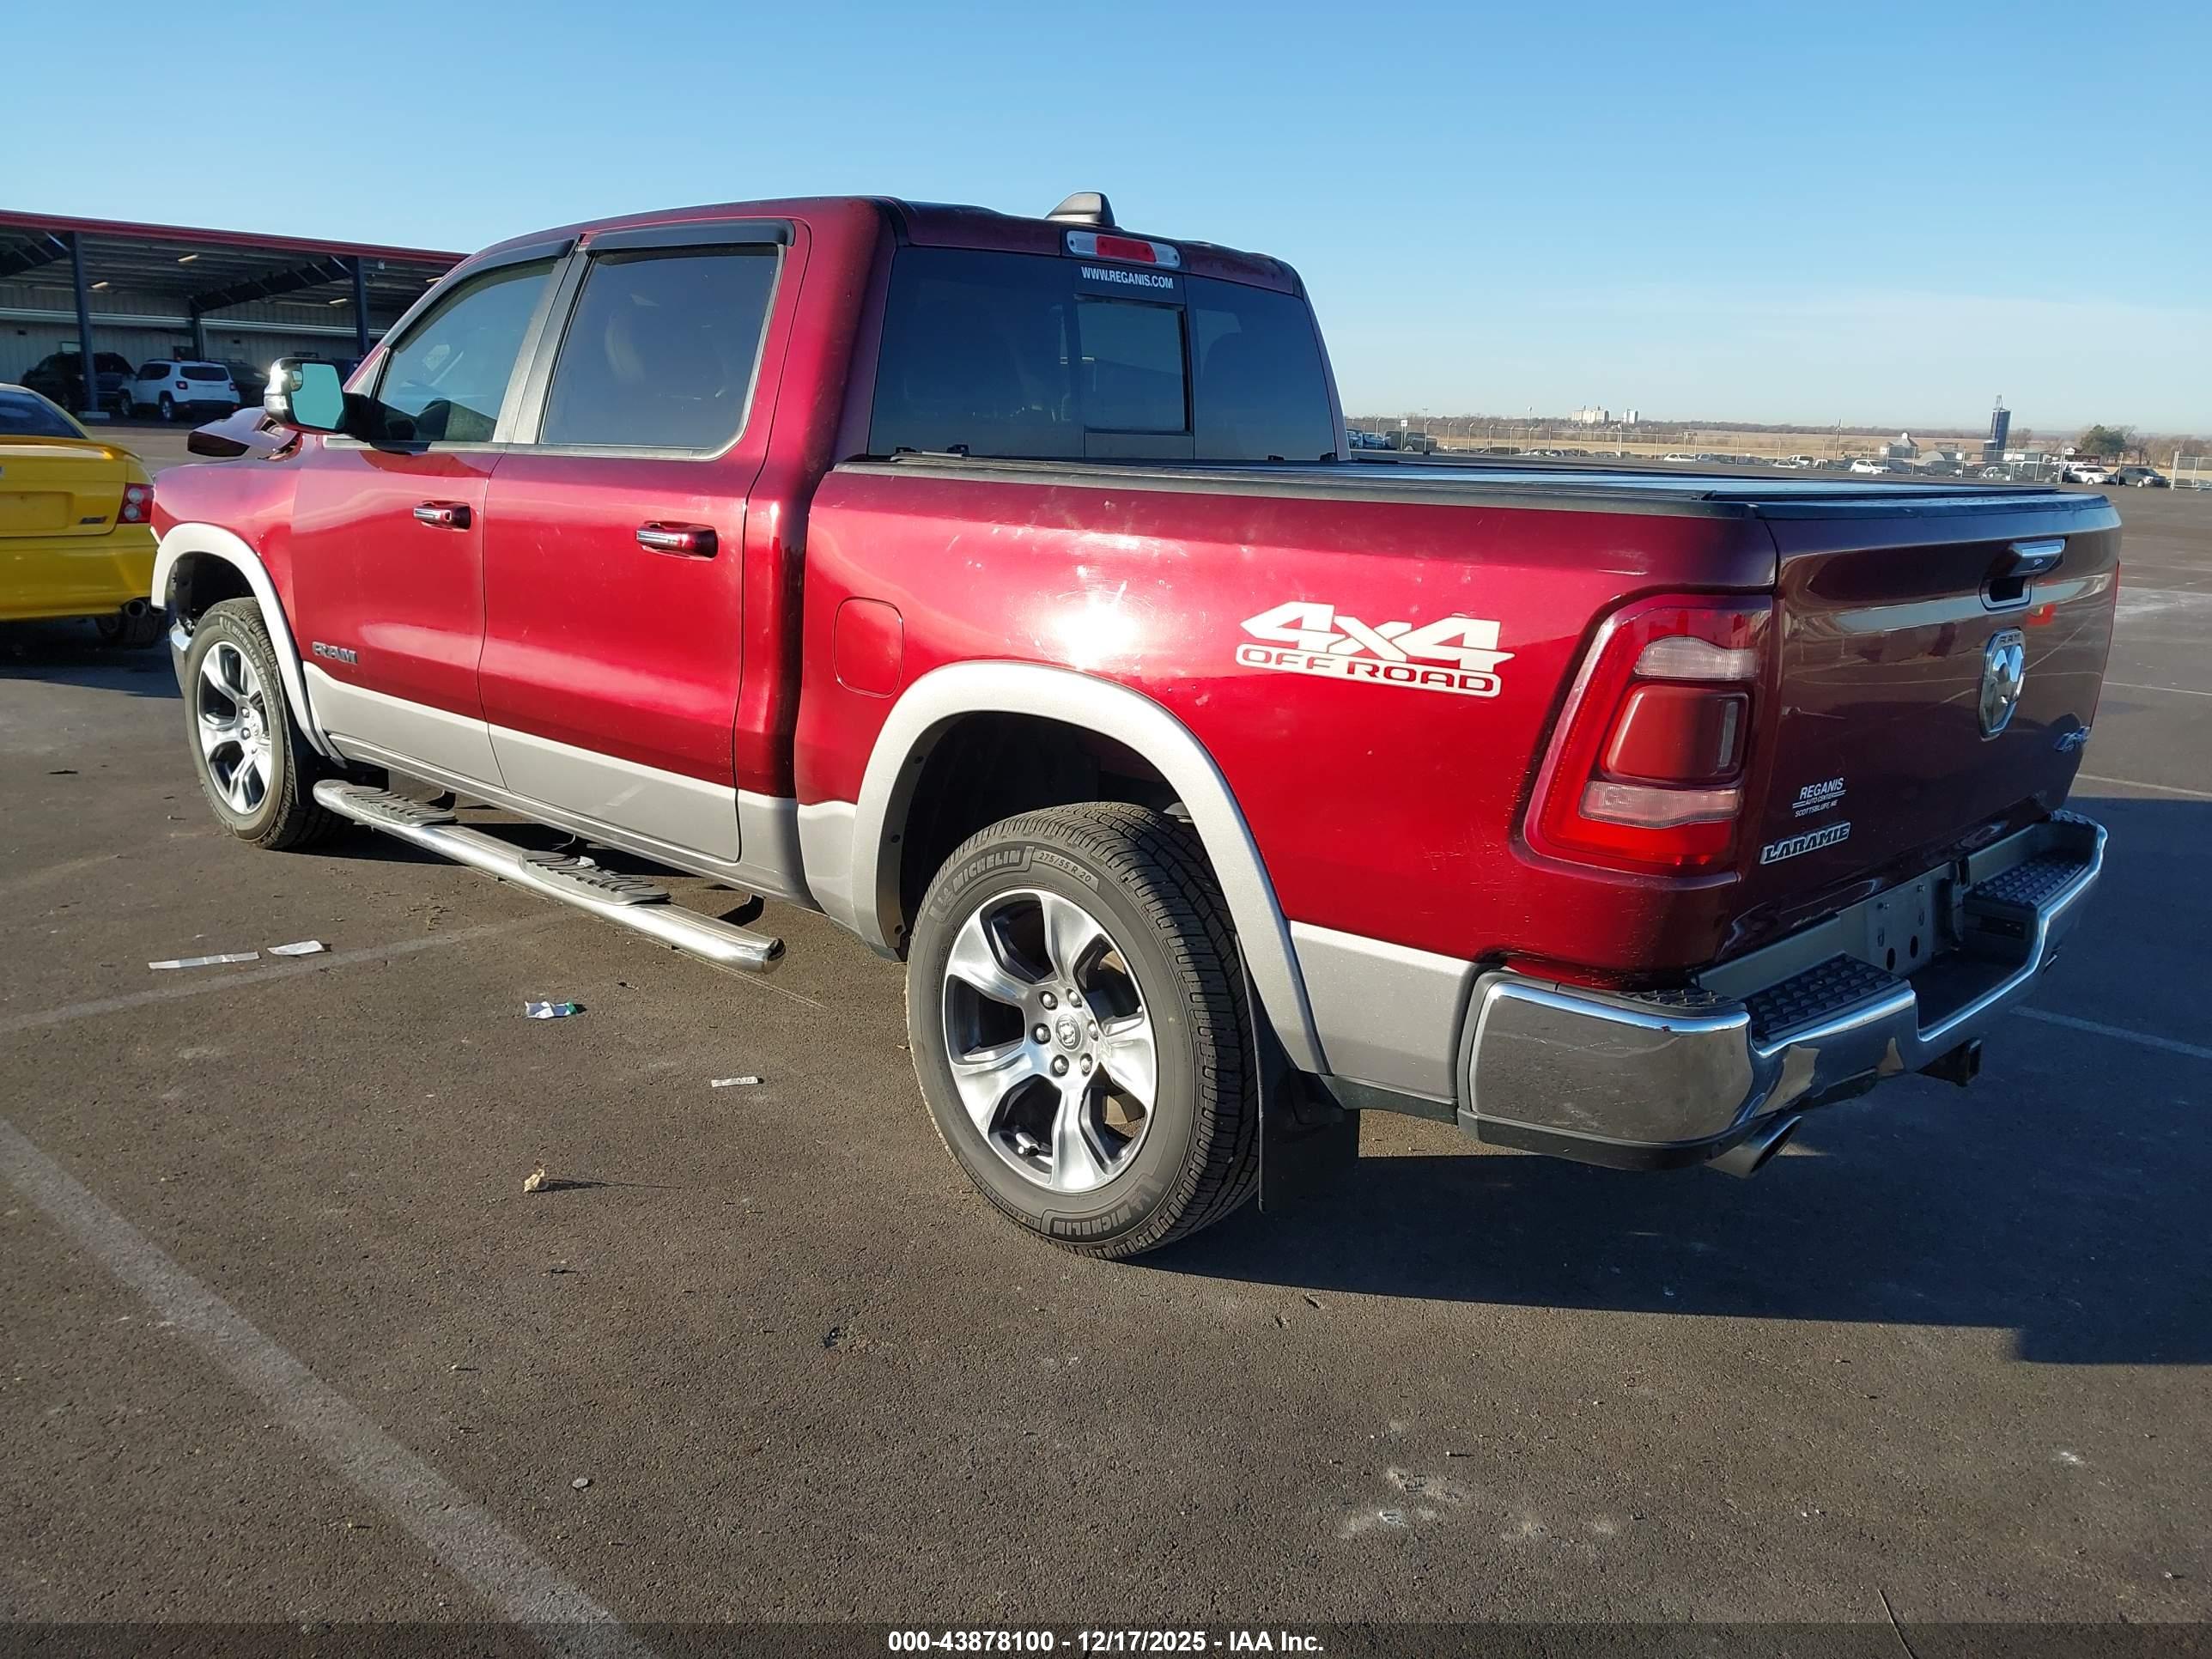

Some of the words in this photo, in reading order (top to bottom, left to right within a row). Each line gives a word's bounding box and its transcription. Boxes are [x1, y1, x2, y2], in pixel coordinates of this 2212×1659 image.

[1080, 265, 1174, 289] WWW.REGANIS.COM
[312, 641, 358, 665] RAM
[1242, 647, 1336, 670] OFF
[1346, 660, 1494, 693] ROAD
[1799, 777, 1844, 799] REGANIS
[1760, 822, 1850, 865] LARAMIE
[952, 849, 1022, 892] MICHELIN
[1038, 852, 1069, 870] 275/55
[1079, 870, 1092, 883] 20
[994, 1196, 1036, 1226] DEFENDER
[1053, 1203, 1133, 1236] MICHELIN
